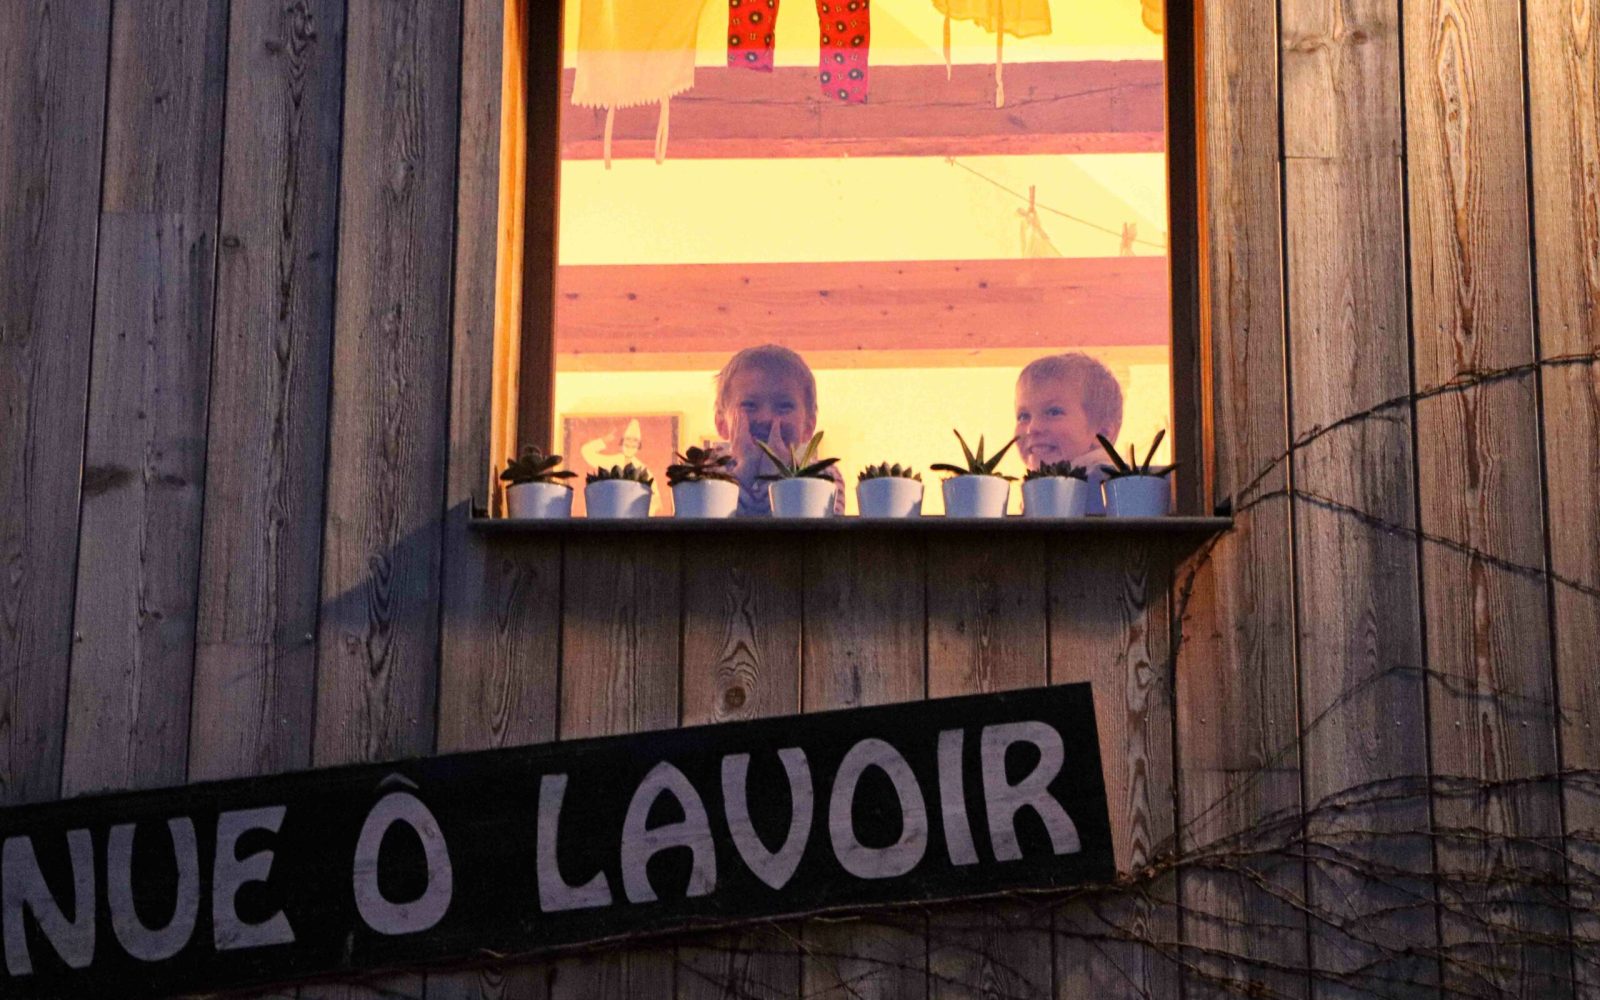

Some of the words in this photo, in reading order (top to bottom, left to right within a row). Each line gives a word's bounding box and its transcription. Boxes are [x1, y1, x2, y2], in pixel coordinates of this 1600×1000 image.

[1, 804, 296, 976] NUE
[352, 771, 453, 936] Ô
[536, 720, 1082, 913] LAVOIR
